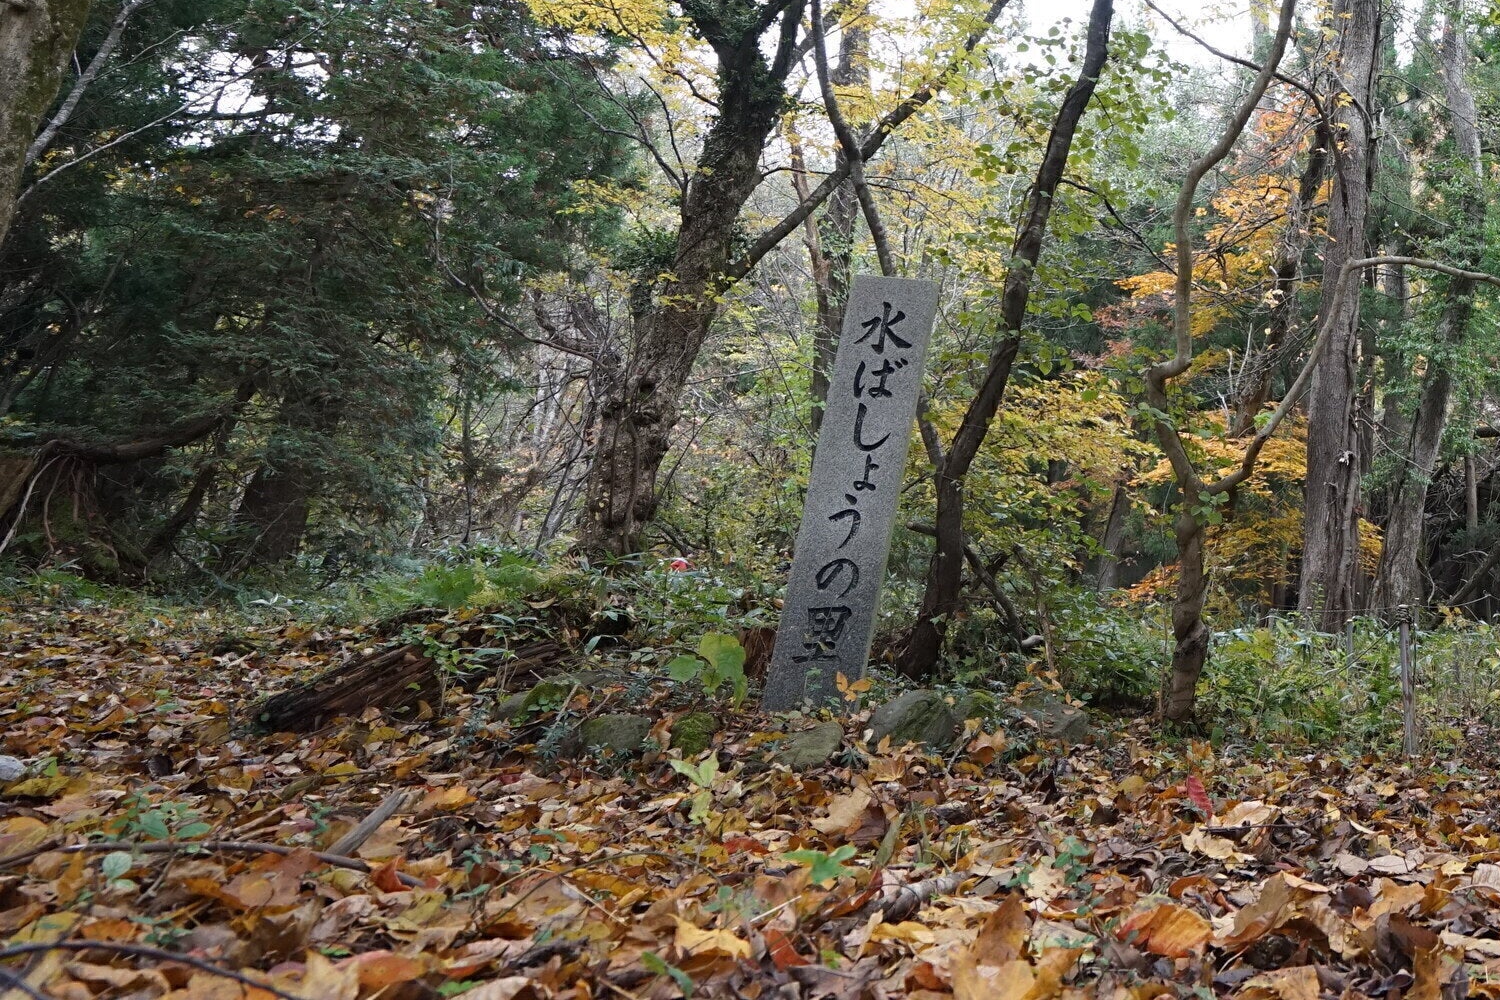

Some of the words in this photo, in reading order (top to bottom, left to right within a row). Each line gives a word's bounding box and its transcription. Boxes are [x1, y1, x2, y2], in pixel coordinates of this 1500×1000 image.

[791, 302, 913, 665] 水ばしょうの里
